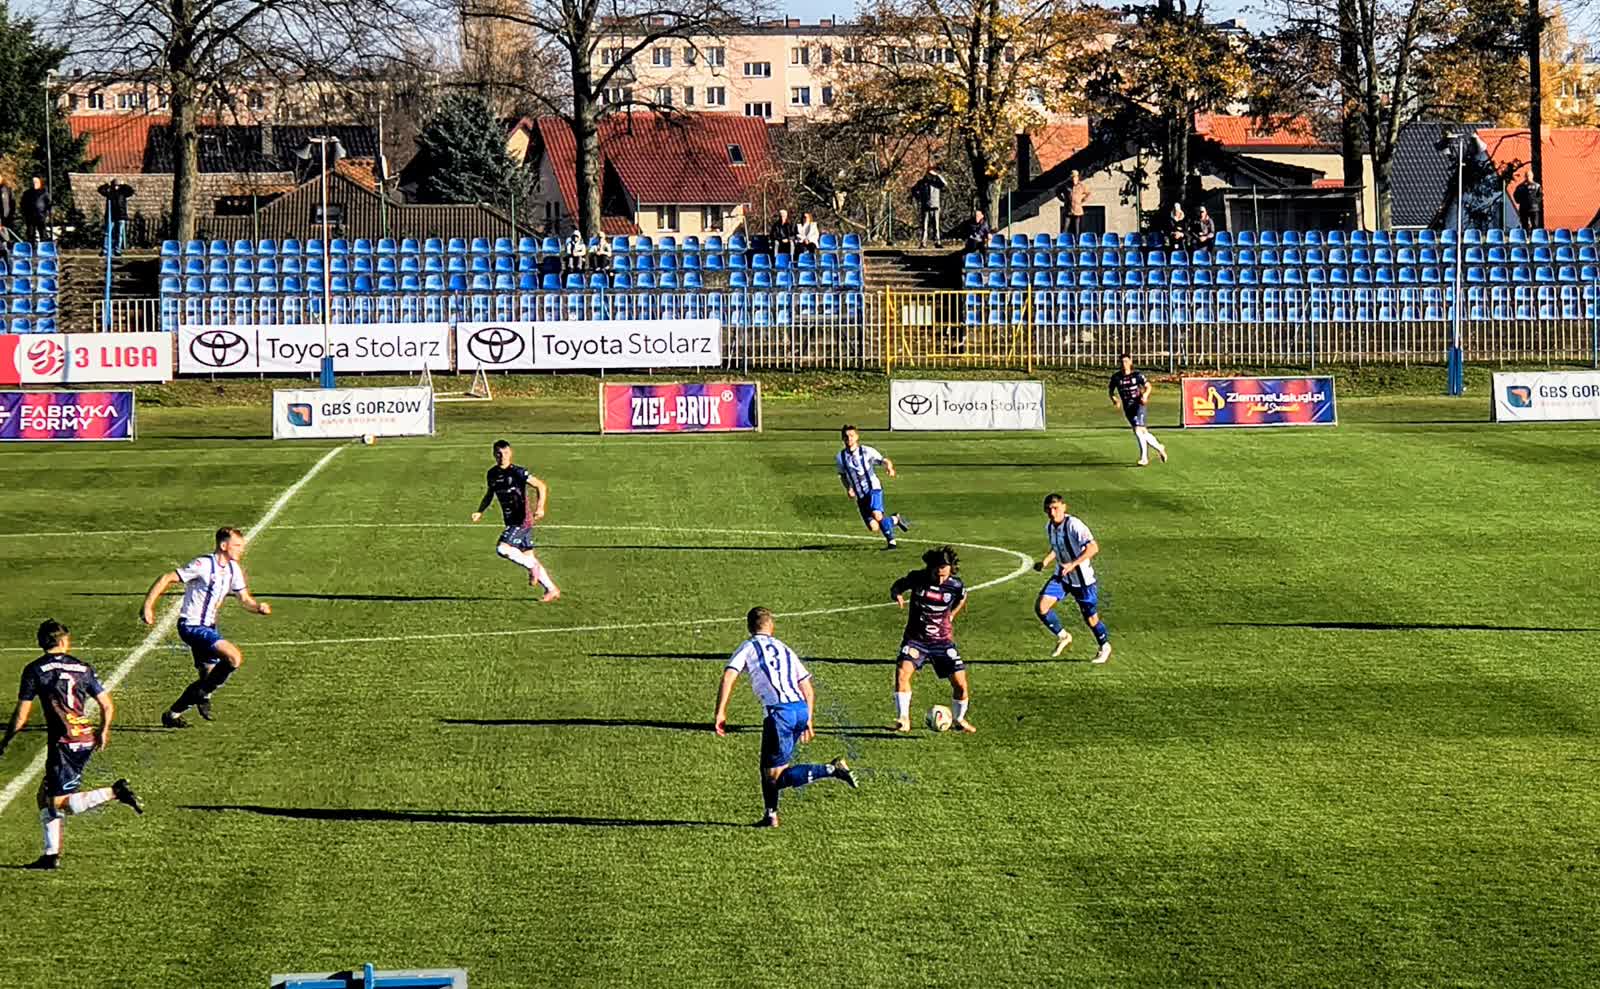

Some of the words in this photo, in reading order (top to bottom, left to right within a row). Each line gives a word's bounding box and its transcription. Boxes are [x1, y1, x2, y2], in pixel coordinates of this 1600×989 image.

[355, 335, 441, 358] Stolarz
[542, 334, 622, 361] Toyota
[628, 331, 712, 354] Stolarz
[75, 347, 90, 368] 3
[100, 346, 158, 368] LIGA
[1539, 385, 1568, 398] GBS
[20, 404, 119, 418] FABRYKA
[321, 402, 351, 417] GBS
[943, 400, 988, 414] Toyota
[990, 399, 1037, 411] Stolarz
[20, 417, 93, 431] FORMY
[765, 644, 781, 670] 3
[59, 672, 76, 709] 7
